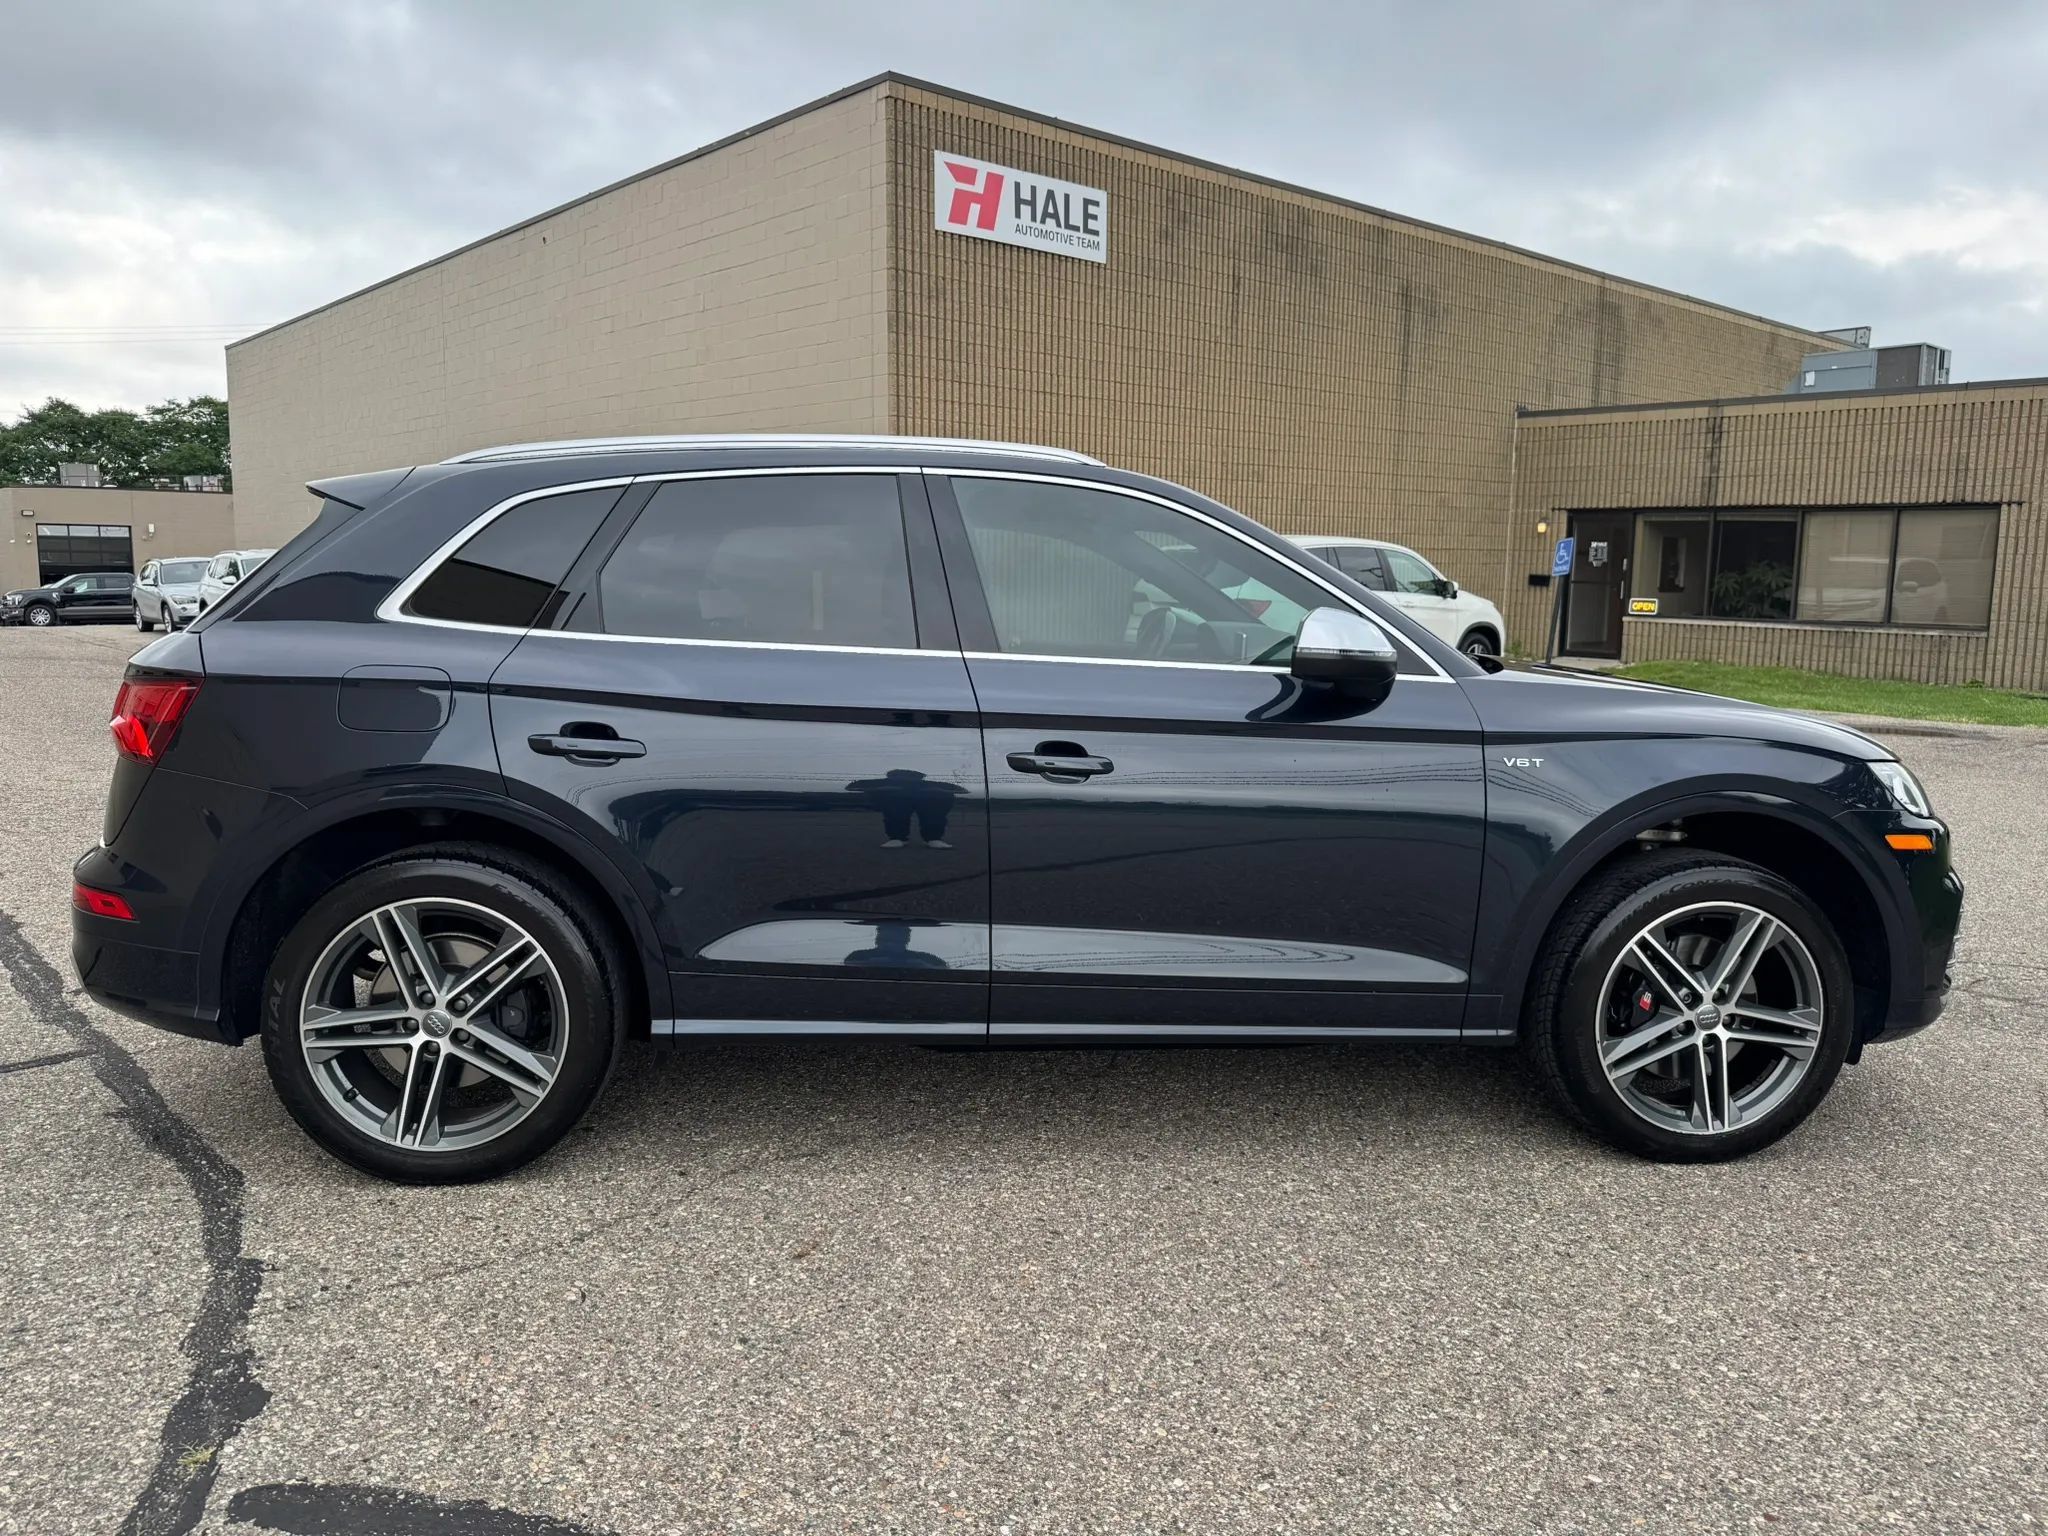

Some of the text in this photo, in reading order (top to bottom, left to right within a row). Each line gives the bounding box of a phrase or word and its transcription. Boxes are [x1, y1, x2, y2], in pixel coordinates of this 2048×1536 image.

[1014, 180, 1100, 237] HALE
[1015, 223, 1100, 251] AUTOMOTIVE TEAM
[1632, 602, 1655, 611] OPEN
[1503, 757, 1545, 768] V6T
